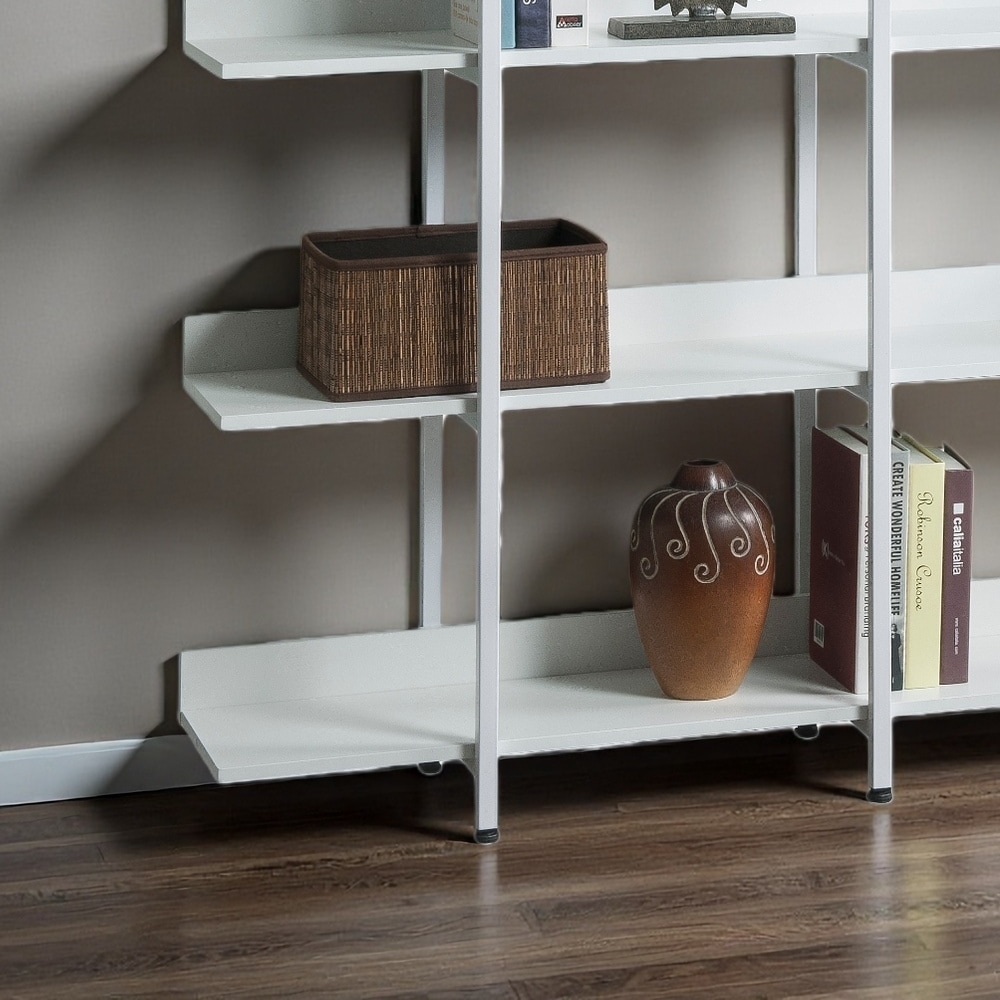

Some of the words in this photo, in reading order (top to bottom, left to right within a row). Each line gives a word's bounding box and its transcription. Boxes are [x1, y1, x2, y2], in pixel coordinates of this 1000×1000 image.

[892, 461, 904, 498] CREATE
[892, 500, 903, 564] WONDERFUL
[916, 492, 934, 558] Robinson
[915, 564, 932, 612] Crusoe
